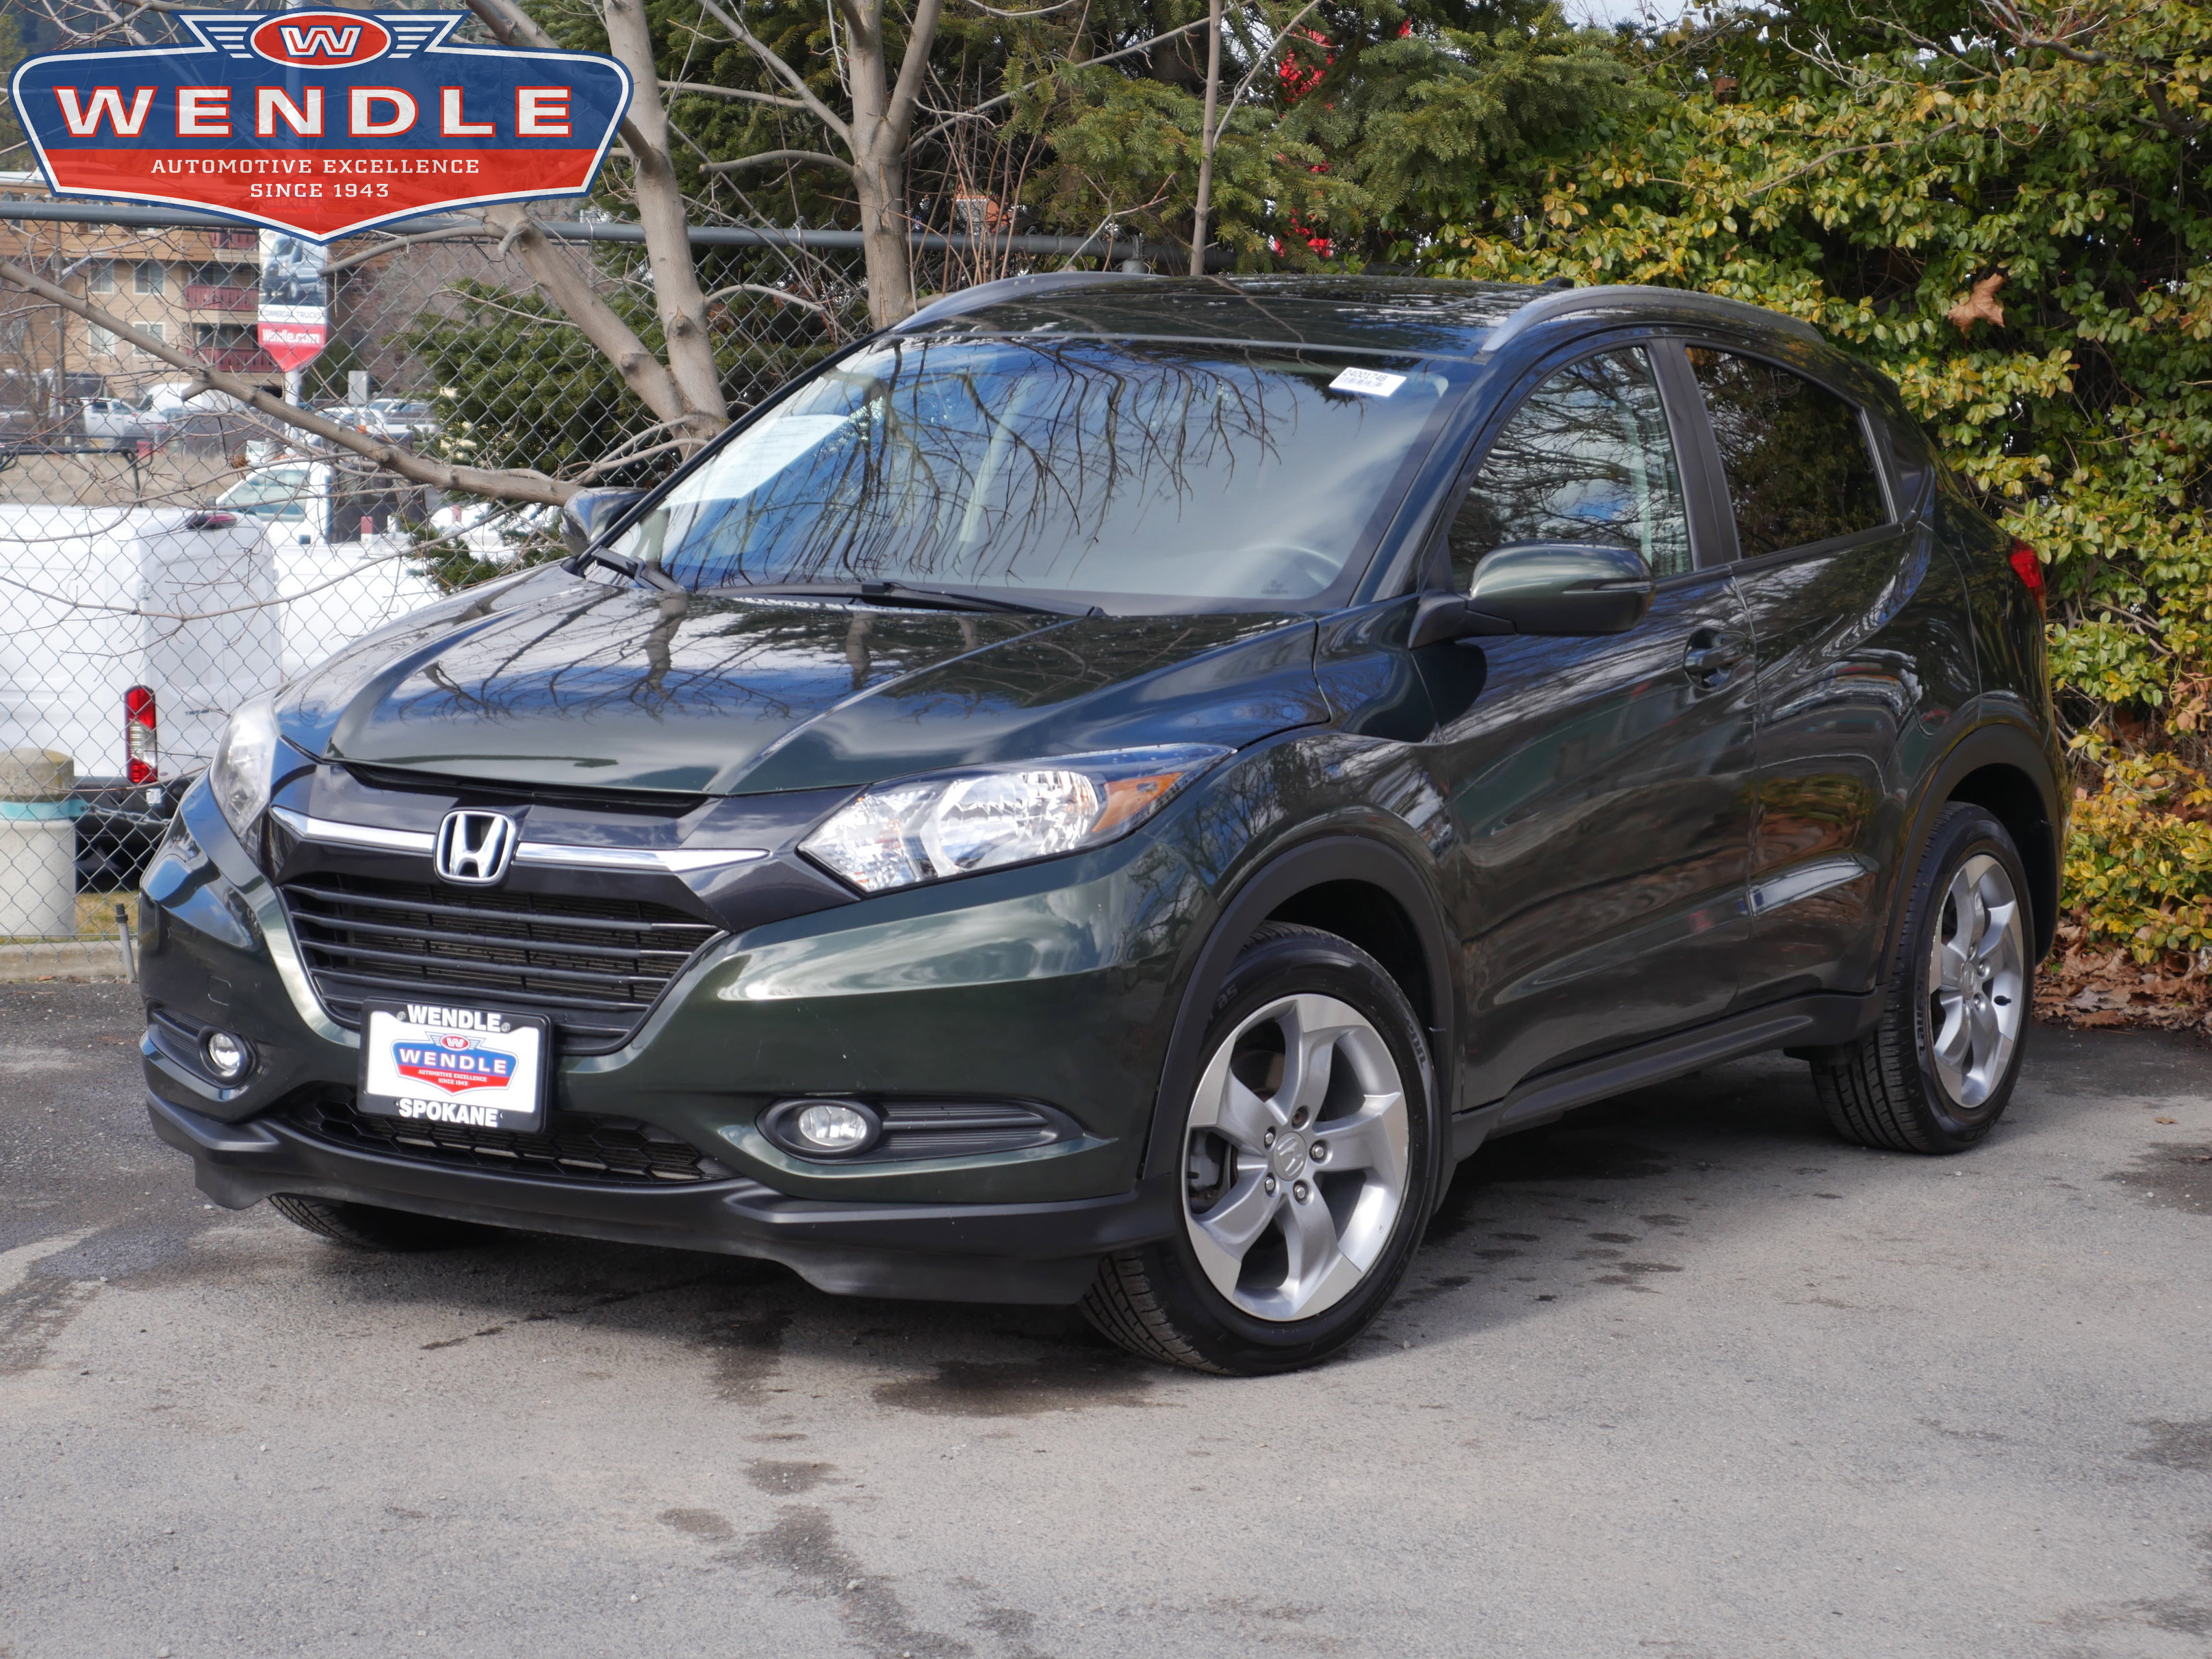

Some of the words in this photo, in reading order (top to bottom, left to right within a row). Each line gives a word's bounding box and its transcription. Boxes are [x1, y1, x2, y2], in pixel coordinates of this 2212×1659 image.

[262, 309, 293, 318] COMMERCIA
[262, 329, 320, 344] Wendle.com
[407, 1004, 502, 1032] WENDLE
[398, 1048, 507, 1075] WENDLE
[417, 1069, 452, 1078] AUTOMOTIVE
[453, 1072, 487, 1083] EXCELLENCE
[398, 1097, 499, 1128] SPOKANE
